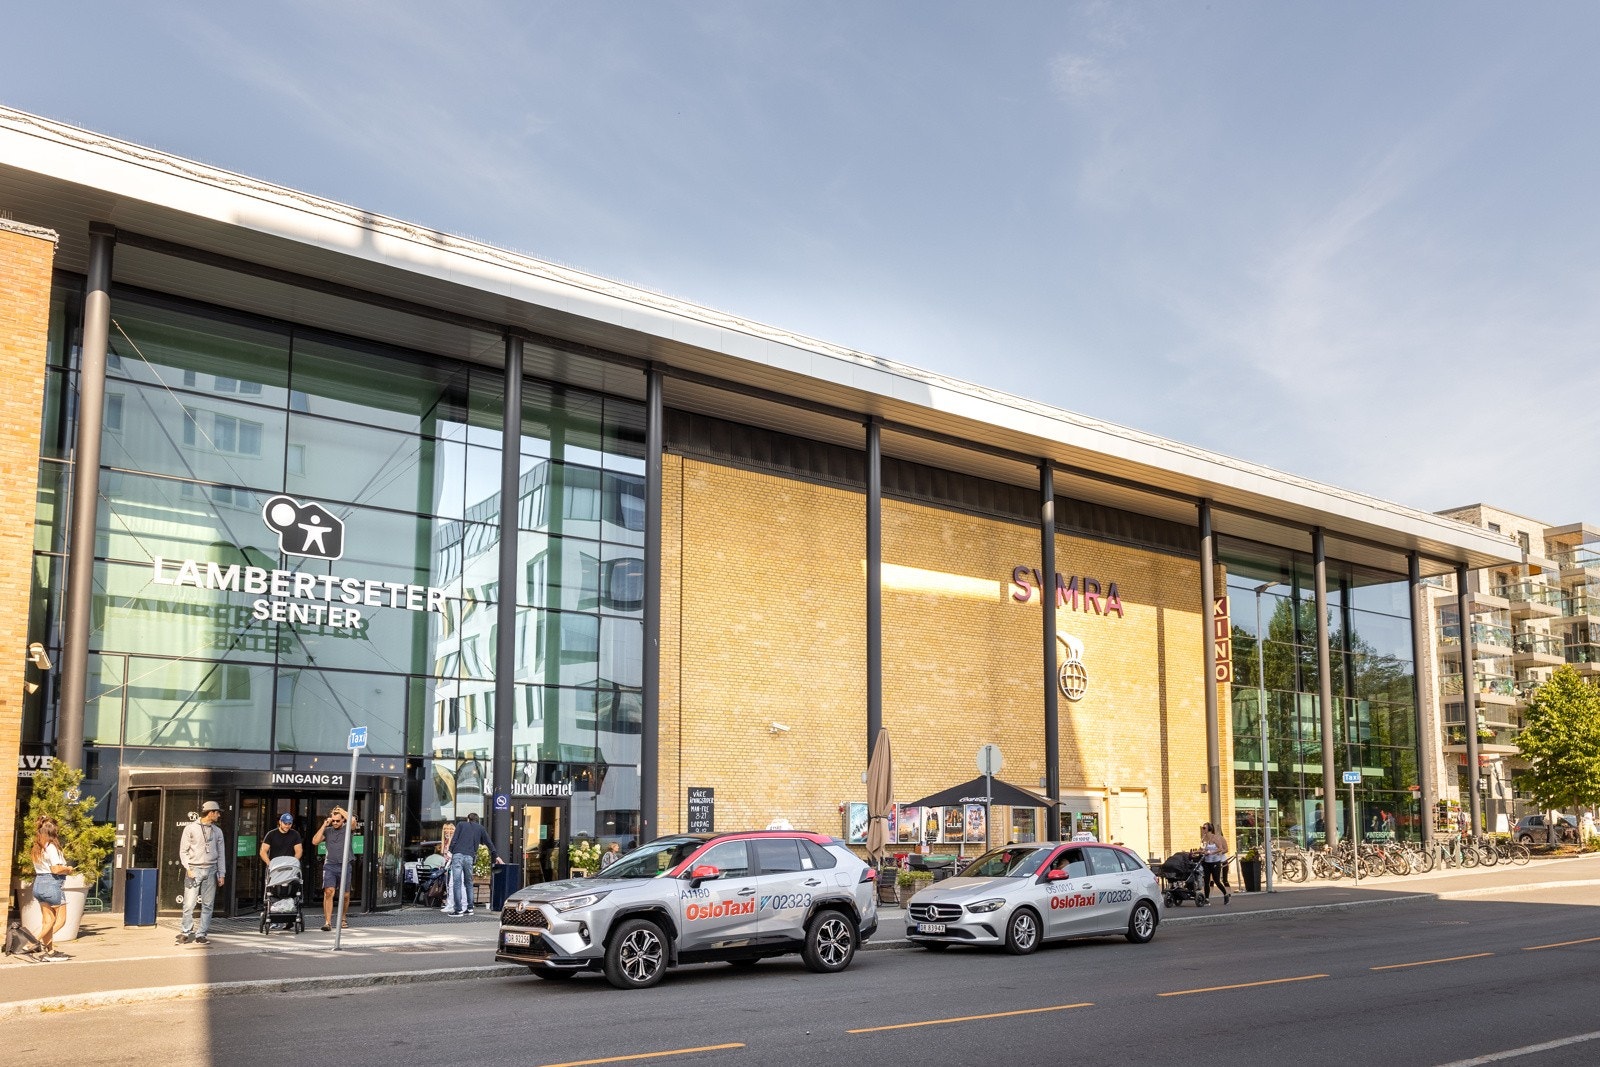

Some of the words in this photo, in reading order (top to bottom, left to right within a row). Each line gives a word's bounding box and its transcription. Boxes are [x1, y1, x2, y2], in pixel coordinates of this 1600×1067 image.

[153, 555, 446, 613] LAMBERTSETER
[252, 598, 361, 629] SENTER
[1214, 599, 1228, 680] KINO
[351, 732, 367, 744] Taxi
[271, 773, 330, 785] INNGANG
[331, 775, 343, 785] 21
[1345, 773, 1360, 781] Taxi
[680, 888, 710, 900] A1180
[1045, 882, 1075, 894] OS10012
[686, 897, 755, 921] OsloTaxi
[772, 893, 812, 910] 02323
[1050, 893, 1095, 910] OsloTaxi
[1106, 889, 1132, 904] 02323
